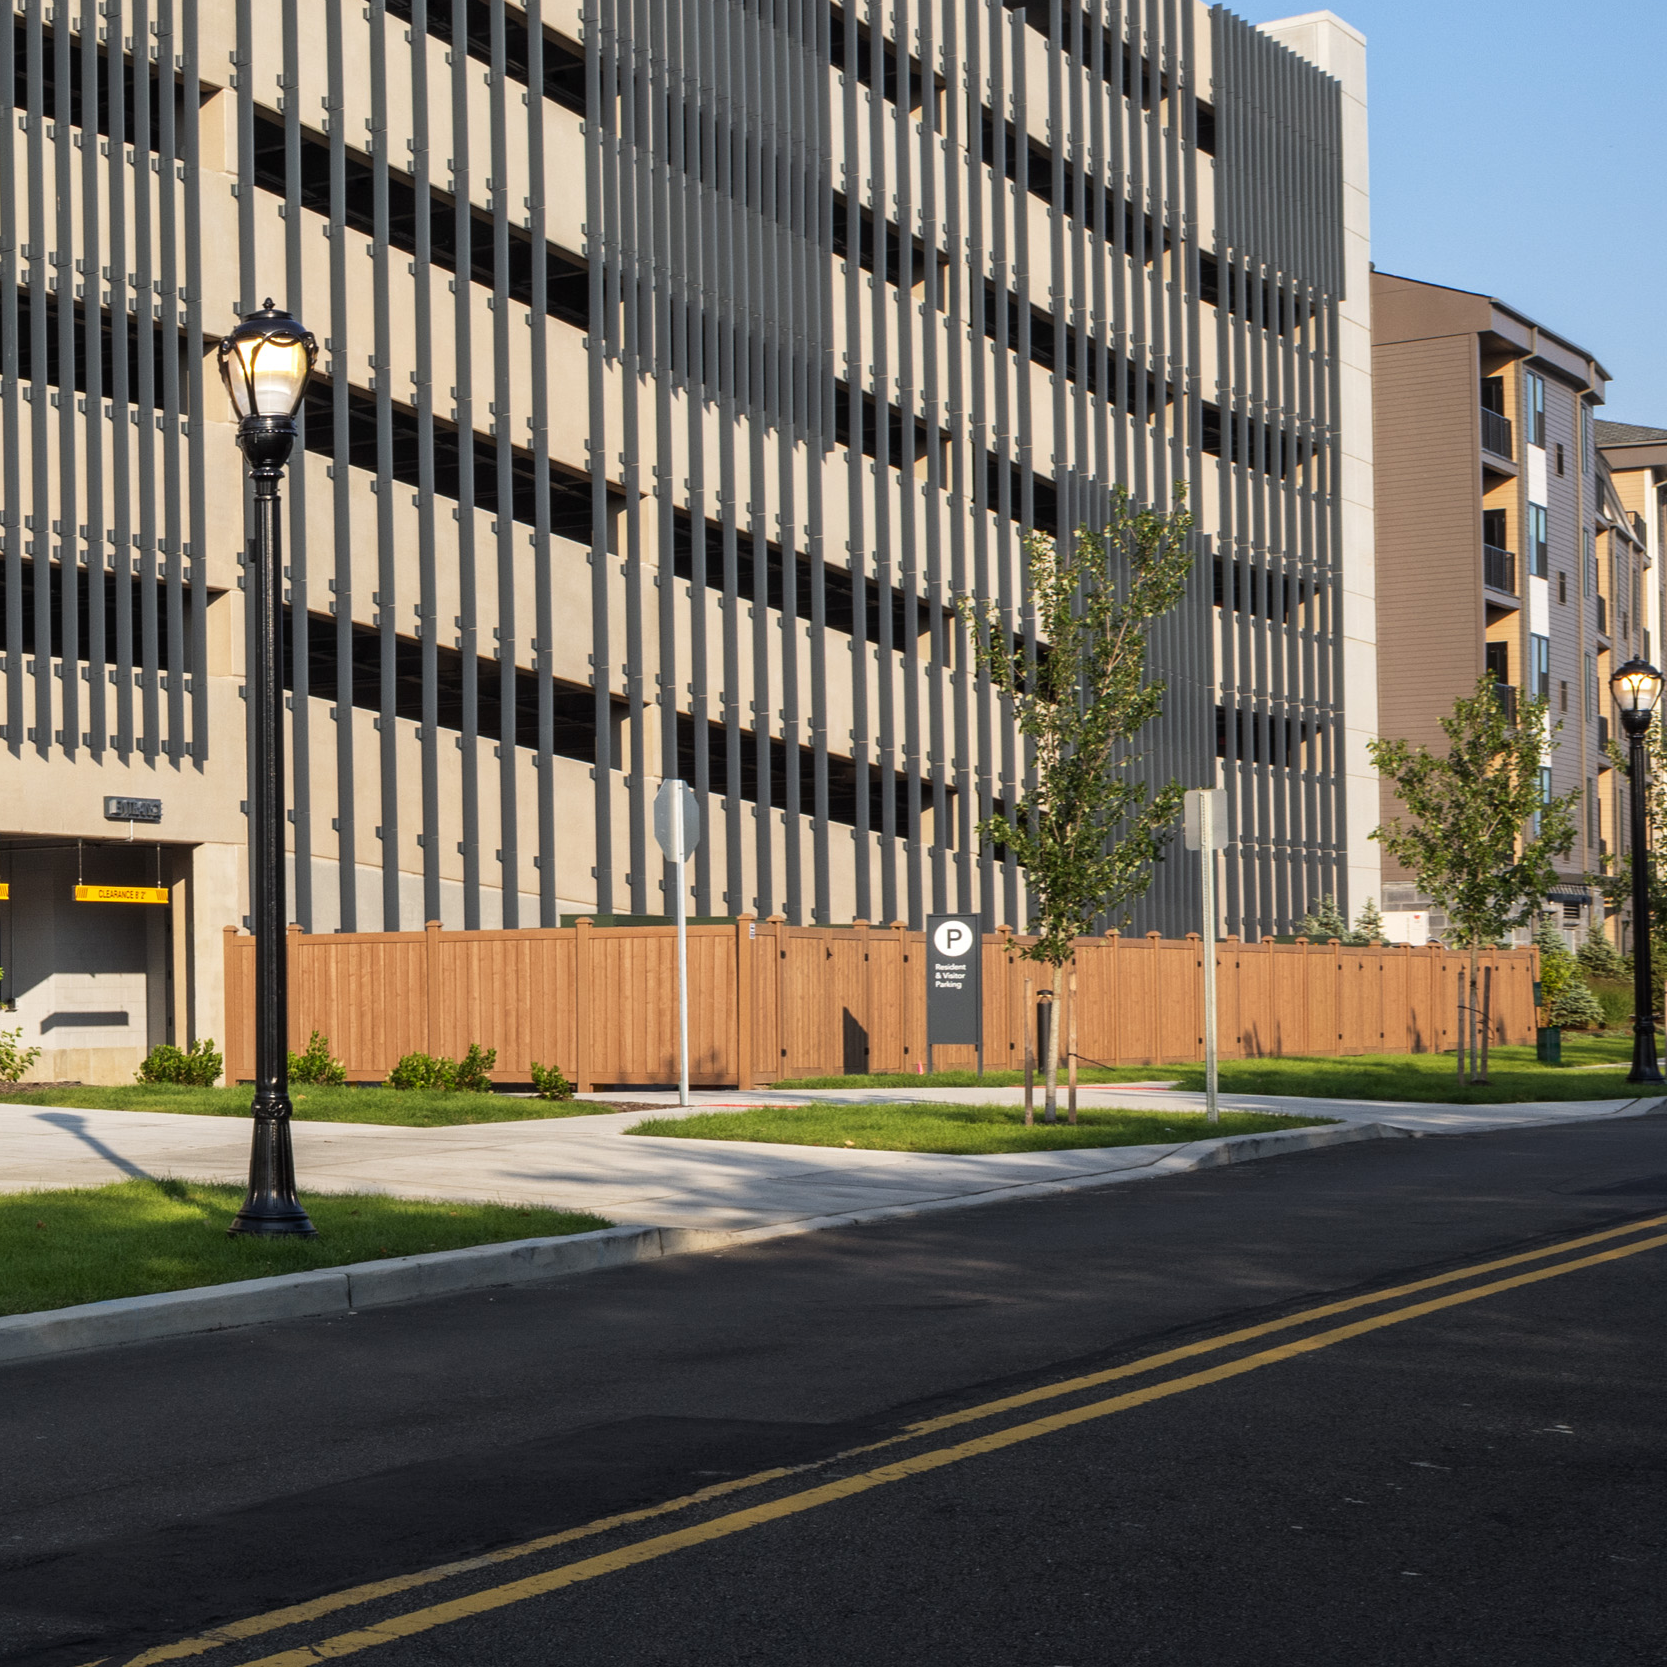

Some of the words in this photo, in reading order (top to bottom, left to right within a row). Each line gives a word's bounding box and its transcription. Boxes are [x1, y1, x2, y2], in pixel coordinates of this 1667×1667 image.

[98, 889, 134, 899] CLEARANCE
[947, 928, 963, 949] P
[935, 980, 962, 989] Parking
